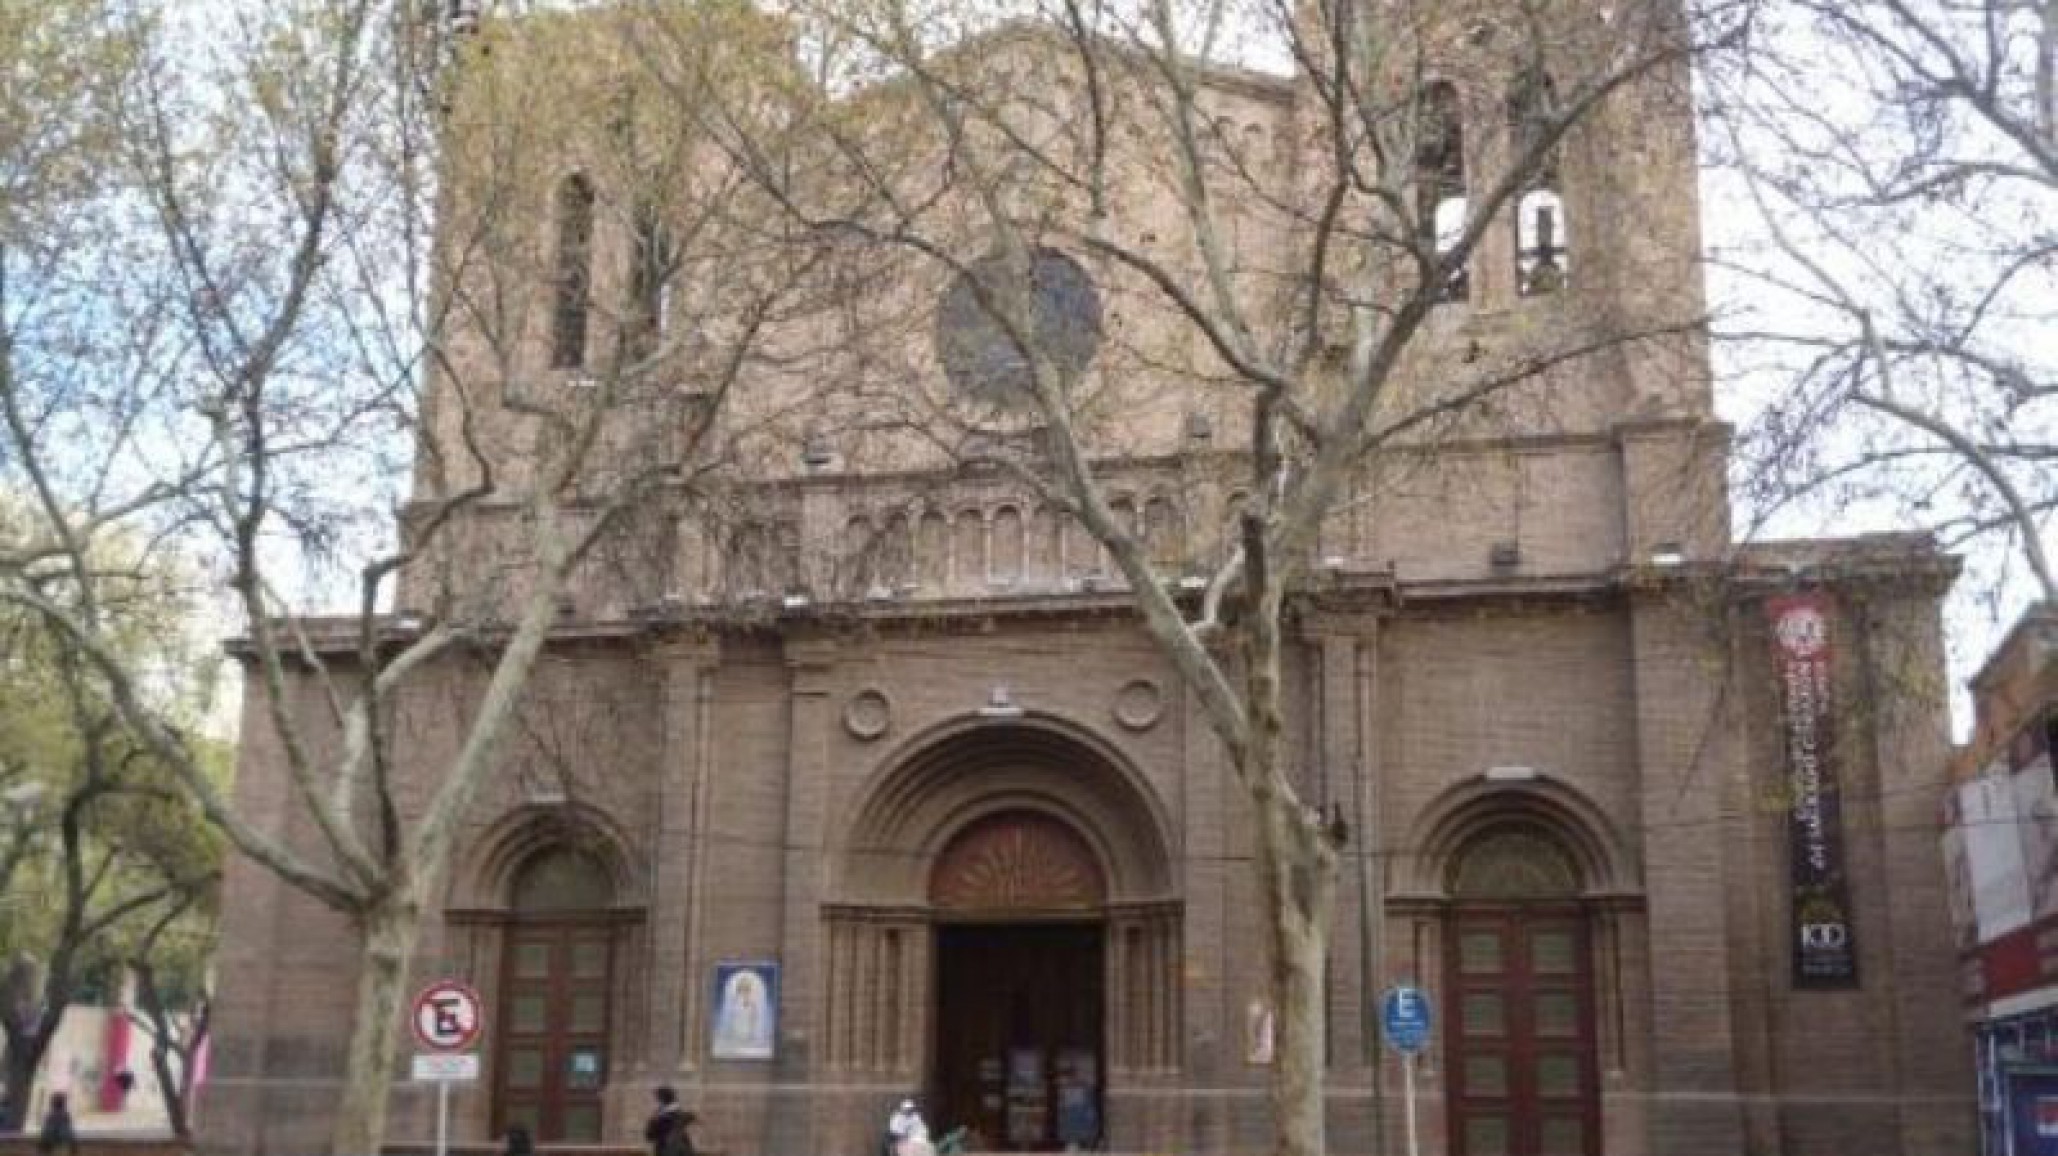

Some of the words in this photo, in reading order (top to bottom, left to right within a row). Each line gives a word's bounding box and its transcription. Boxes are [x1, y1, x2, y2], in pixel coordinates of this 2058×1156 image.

[1801, 923, 1846, 948] 100
[433, 998, 461, 1037] E
[1397, 987, 1416, 1018] E
